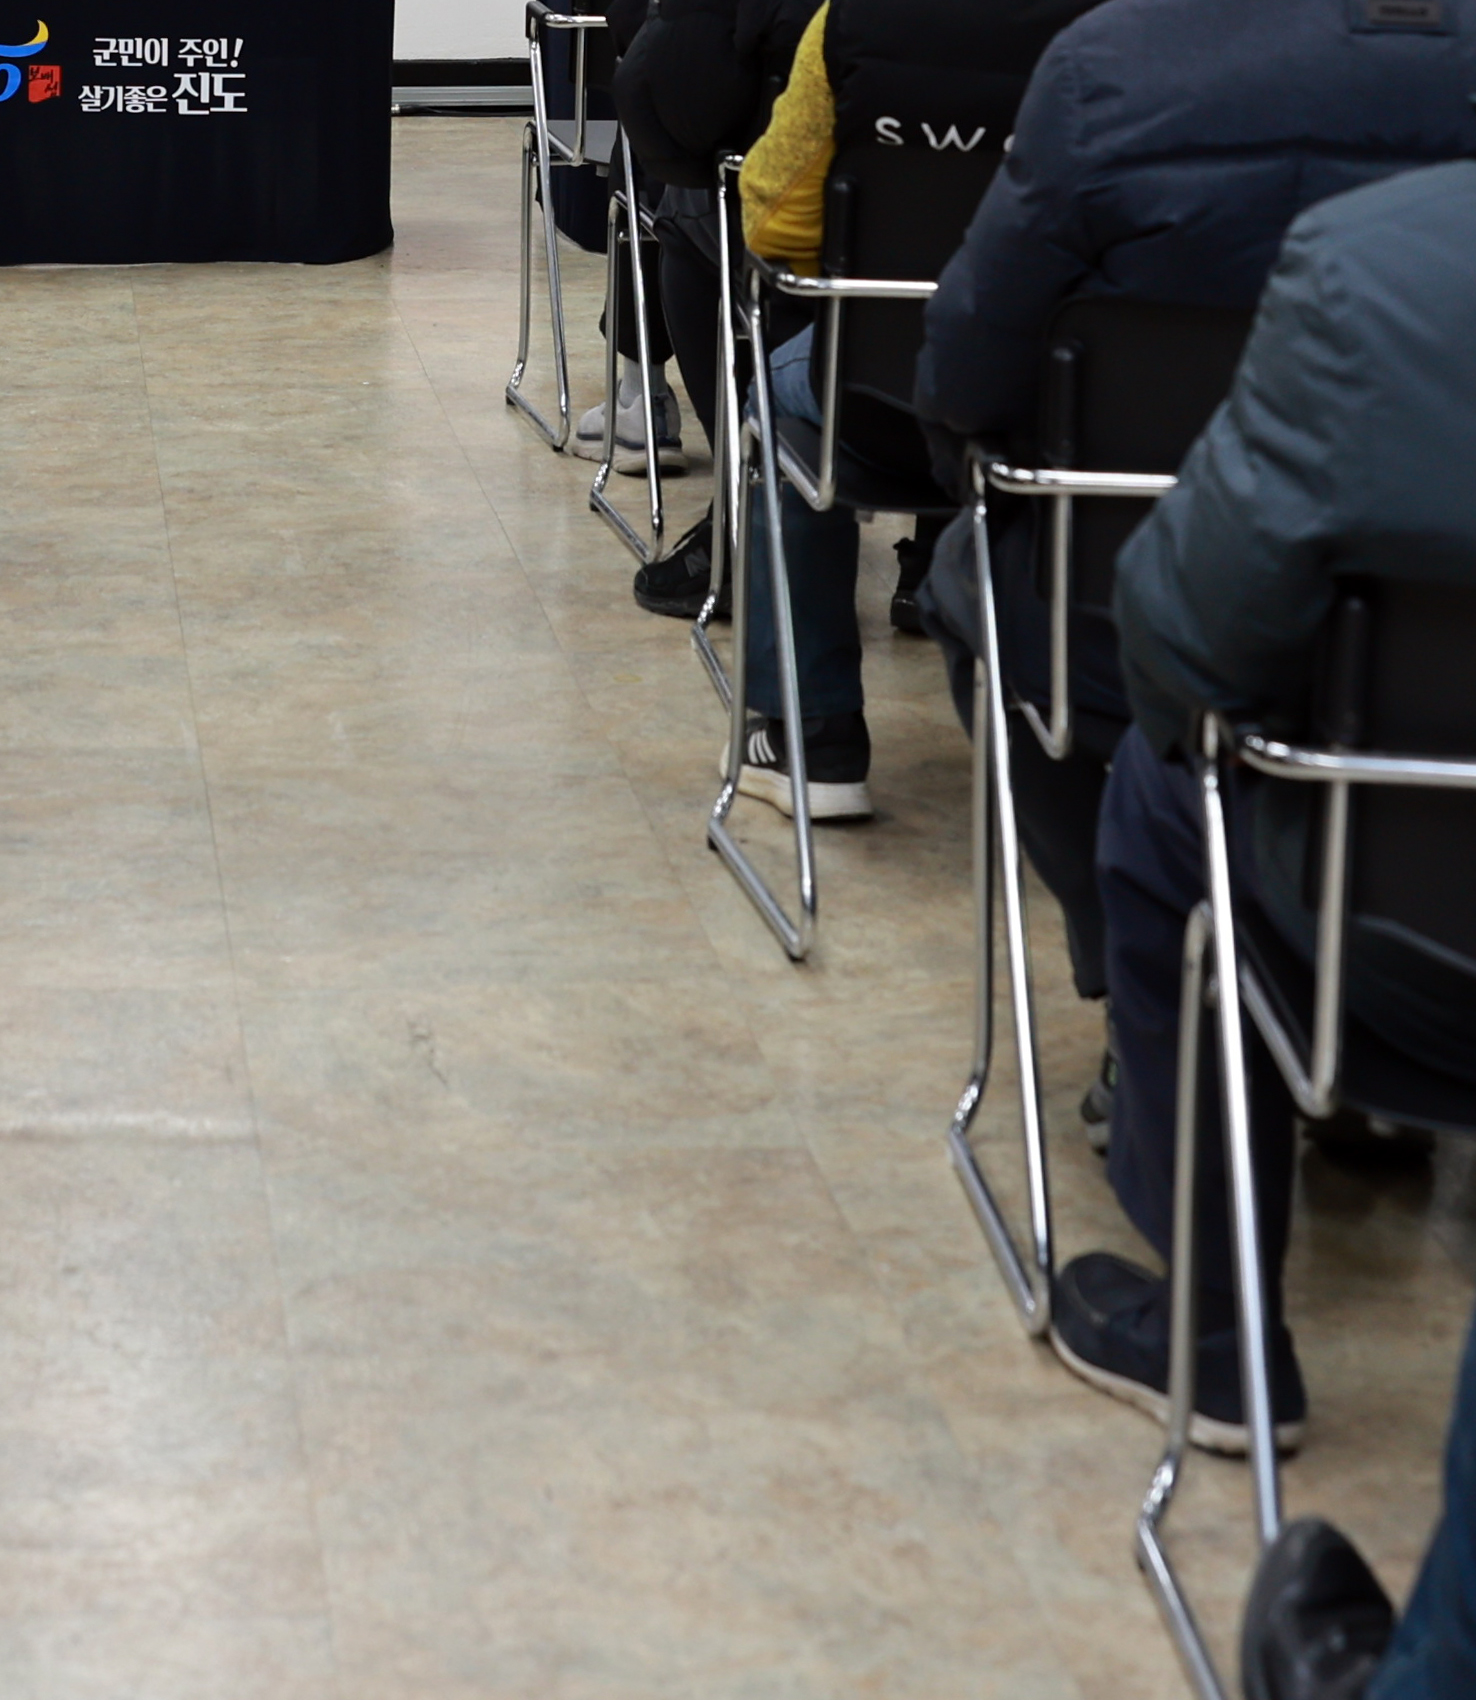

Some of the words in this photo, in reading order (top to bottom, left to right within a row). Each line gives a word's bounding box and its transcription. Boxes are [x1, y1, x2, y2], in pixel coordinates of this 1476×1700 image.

[92, 37, 169, 69] 군민이
[177, 37, 245, 68] 주인!
[78, 84, 167, 114] 살기좋은
[171, 71, 248, 115] 진도
[875, 116, 1015, 153] SW
